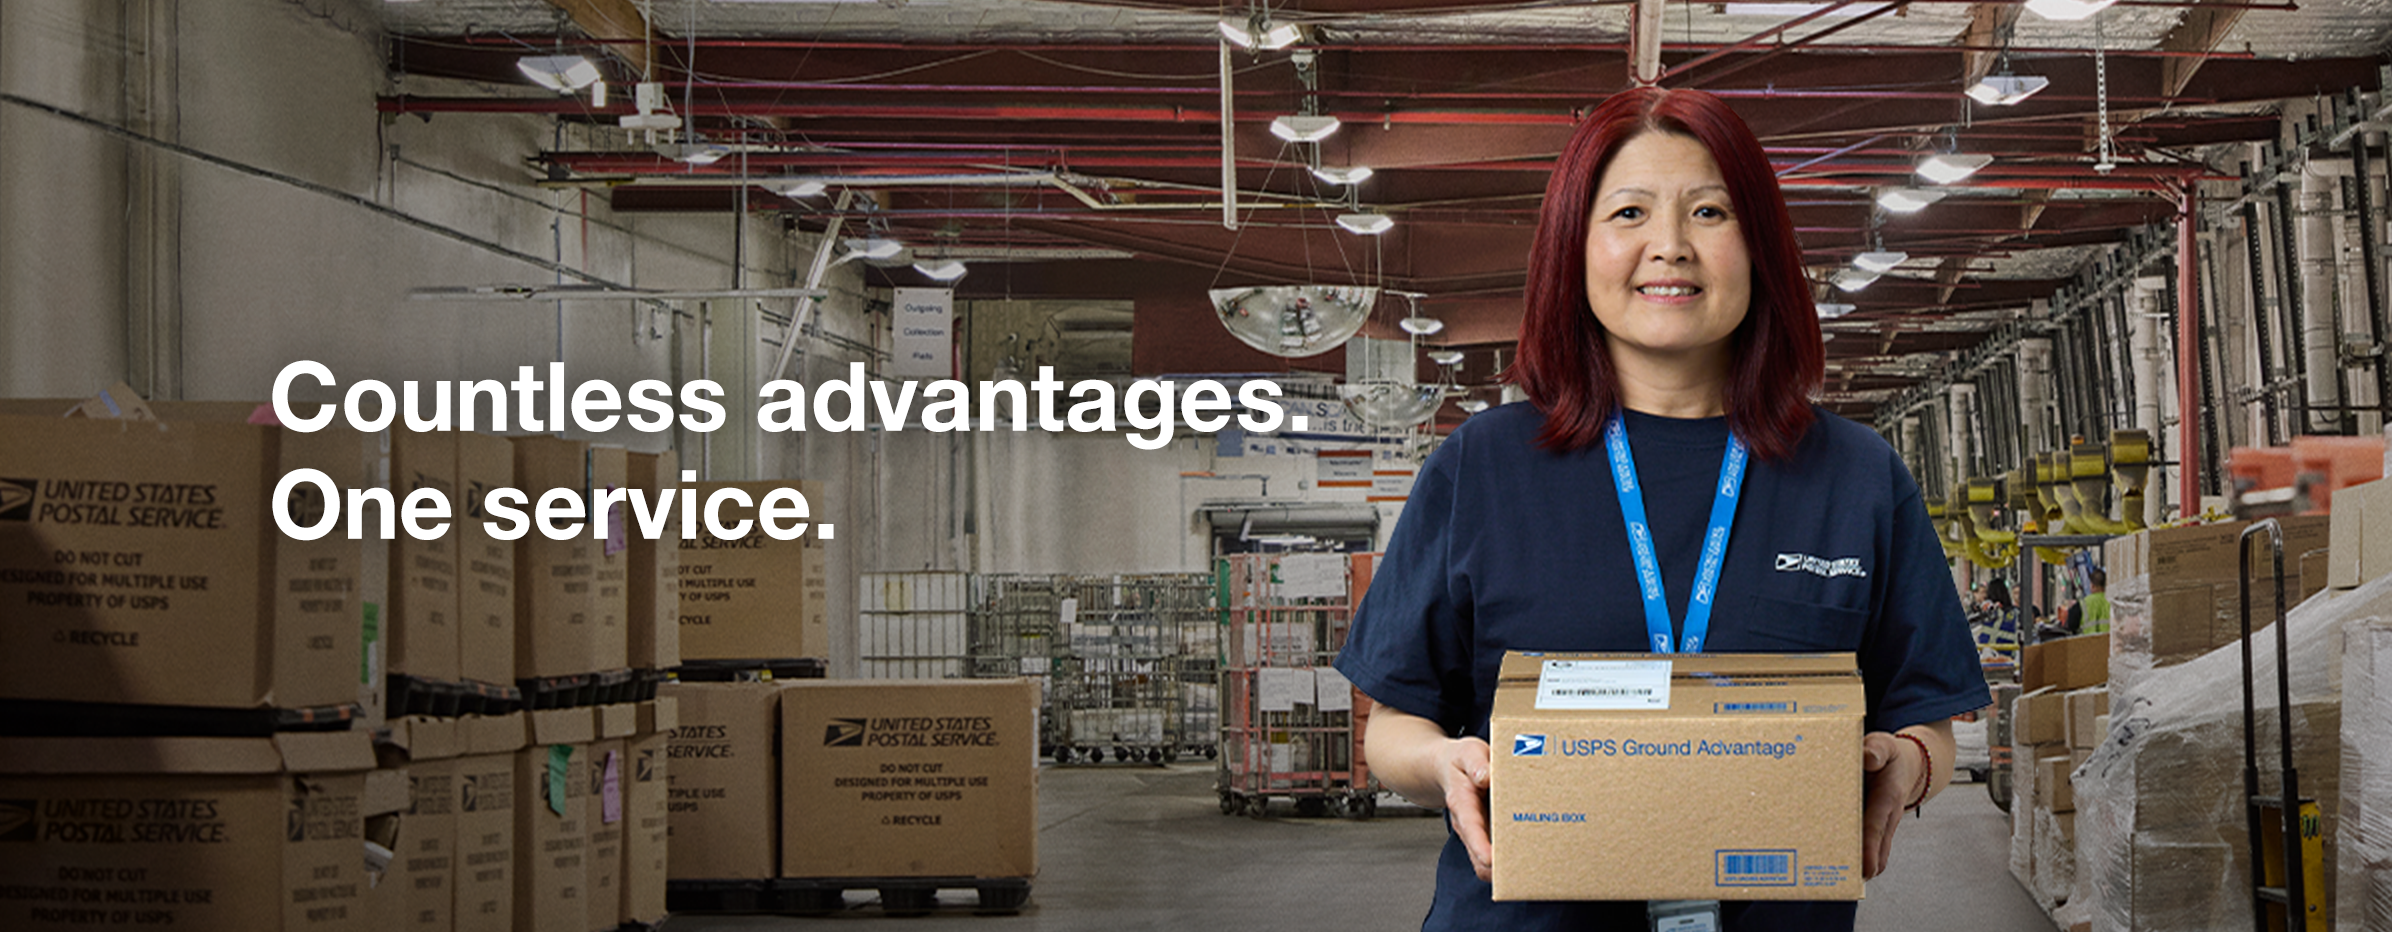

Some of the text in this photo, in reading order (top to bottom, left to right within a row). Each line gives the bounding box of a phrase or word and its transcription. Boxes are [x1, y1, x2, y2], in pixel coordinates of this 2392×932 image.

[904, 303, 943, 314] Outgoing
[903, 327, 945, 337] Collection
[45, 480, 217, 504] UNITED STATES
[39, 503, 121, 526] POSTAL
[54, 550, 143, 567] DO NOT CUT
[679, 565, 713, 575] OT CUT
[0, 570, 209, 591] ESIGNED FOR MULTIPLE USE
[685, 578, 756, 589] MULTIPLE USE
[27, 591, 170, 611] PROPERTY OF USPS
[689, 592, 731, 602] OF USPS
[679, 615, 712, 625] CYCLE
[70, 630, 140, 648] RECYCLE
[871, 717, 992, 732] UNITED STATES
[867, 732, 929, 747] POSTAL
[1562, 738, 1617, 756] USPS
[1622, 738, 1692, 756] Ground
[880, 763, 943, 774] DO NOT CUT
[834, 776, 989, 788] DESIGNED FOR MULTIPLE USE
[668, 788, 726, 798] TIPLE USE
[861, 790, 963, 802] PROPERTY OF USPS
[44, 799, 219, 820] UNITED STATES
[893, 815, 943, 826] RECYCLE
[1513, 812, 1587, 823] MAILING BOX
[45, 822, 126, 843] POSTAL
[58, 866, 148, 882] DO NOT CUT
[72, 887, 102, 902] FOR
[105, 888, 179, 904] MULTIPLE
[183, 889, 213, 904] USE
[31, 907, 174, 926] PROPERTY OF USPS
